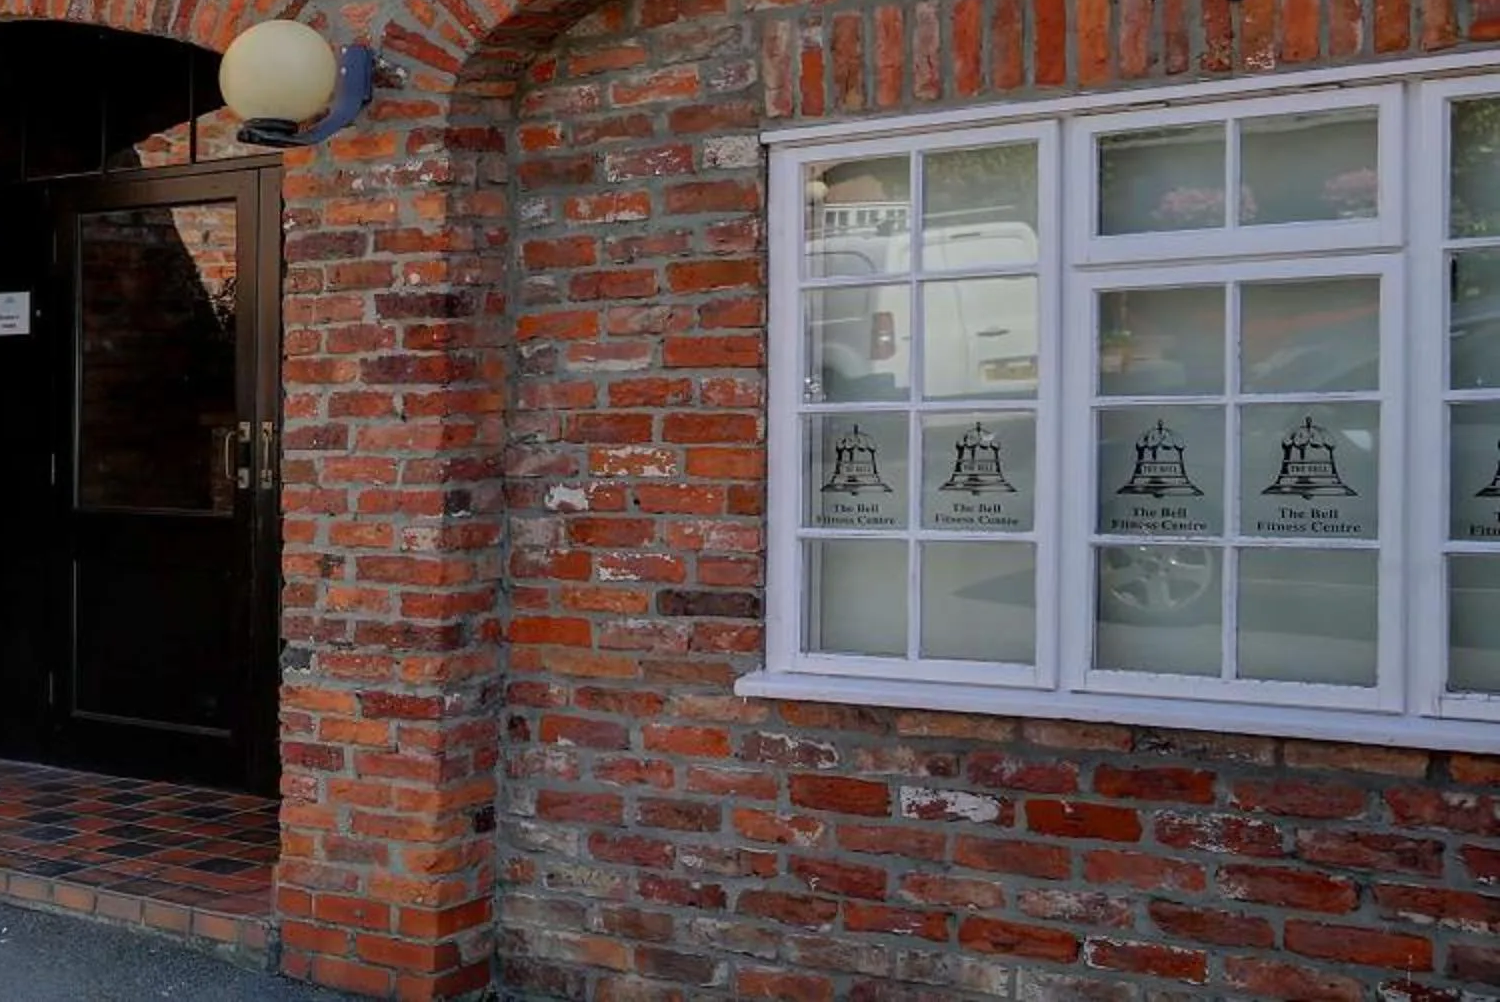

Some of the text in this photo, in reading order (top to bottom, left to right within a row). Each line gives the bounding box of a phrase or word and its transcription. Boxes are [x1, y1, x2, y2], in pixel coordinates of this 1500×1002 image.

[834, 503, 879, 513] The Bell
[953, 503, 1002, 513] The Bell
[1133, 507, 1188, 518] The Bell
[1280, 507, 1339, 519] The Bell
[857, 515, 896, 525] Centre
[1161, 520, 1208, 531] Centre
[1257, 521, 1363, 533] Fitness Centre
